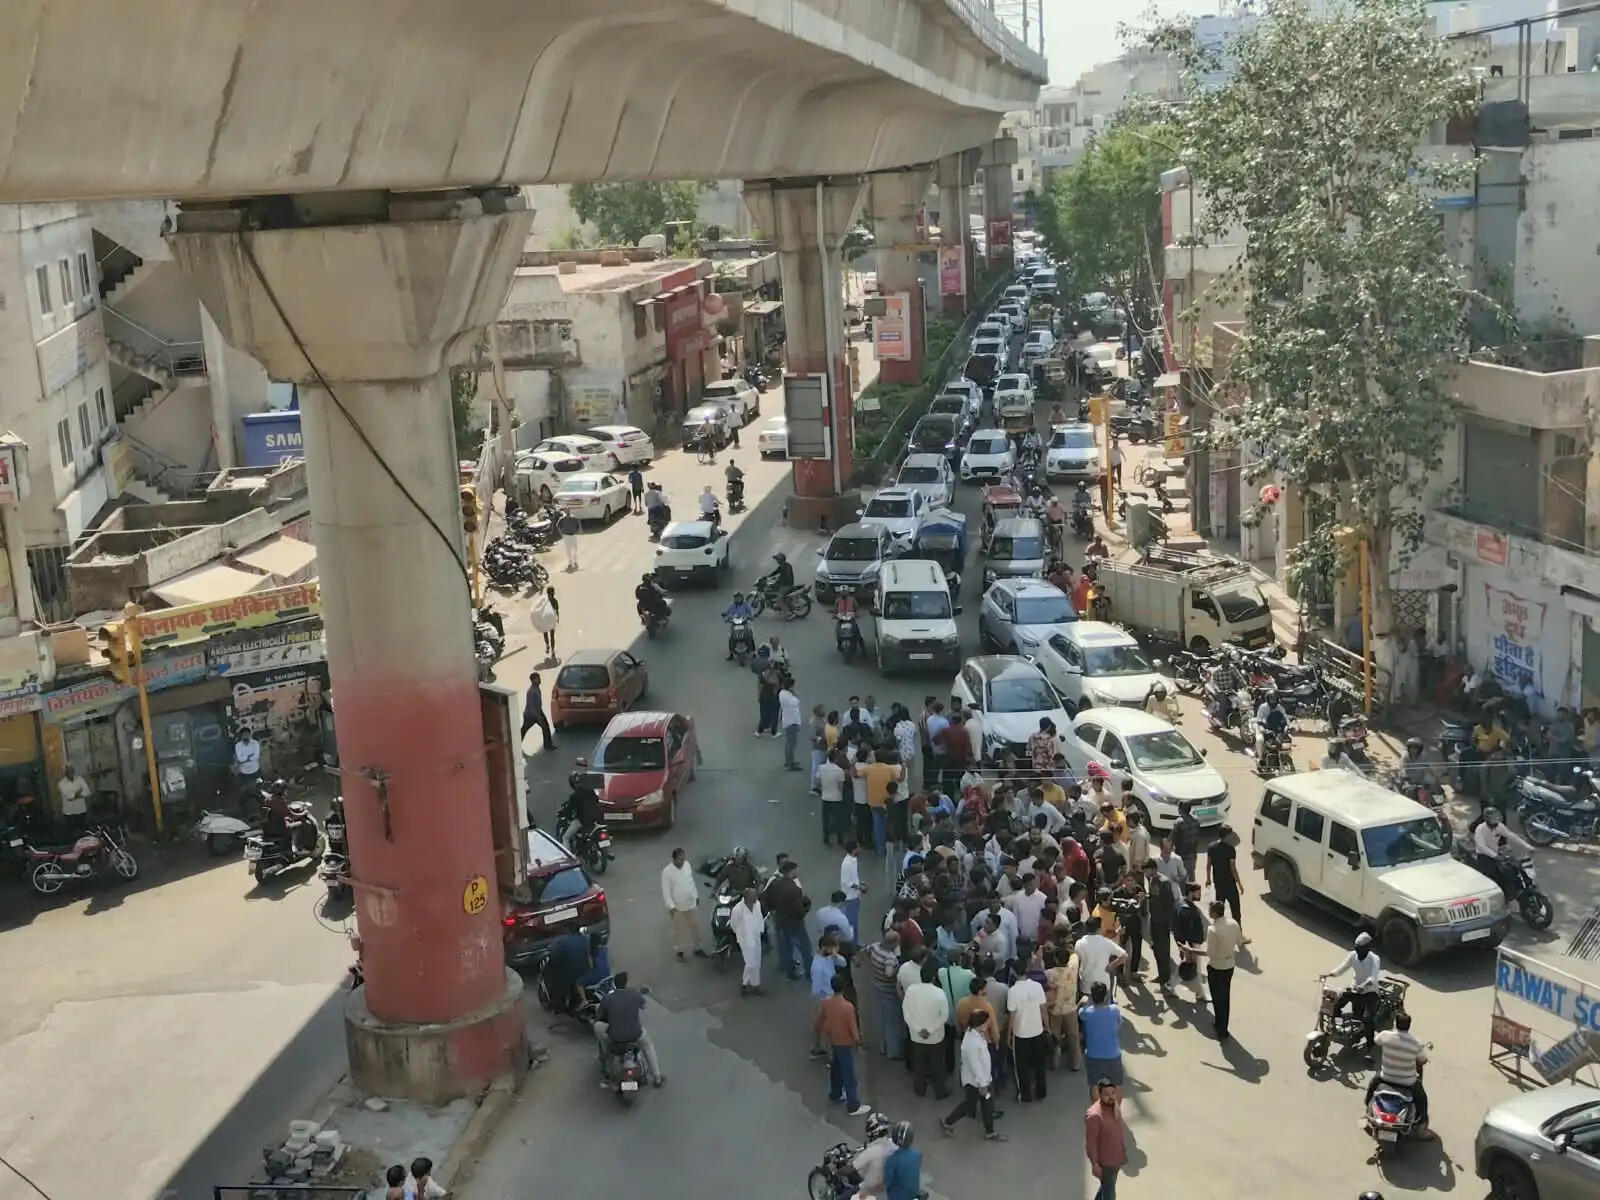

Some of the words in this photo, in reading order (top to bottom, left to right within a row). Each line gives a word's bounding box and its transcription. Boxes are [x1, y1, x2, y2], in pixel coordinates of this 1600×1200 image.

[471, 882, 479, 896] P
[470, 893, 486, 912] 125
[1498, 961, 1567, 1014] RAWAT
